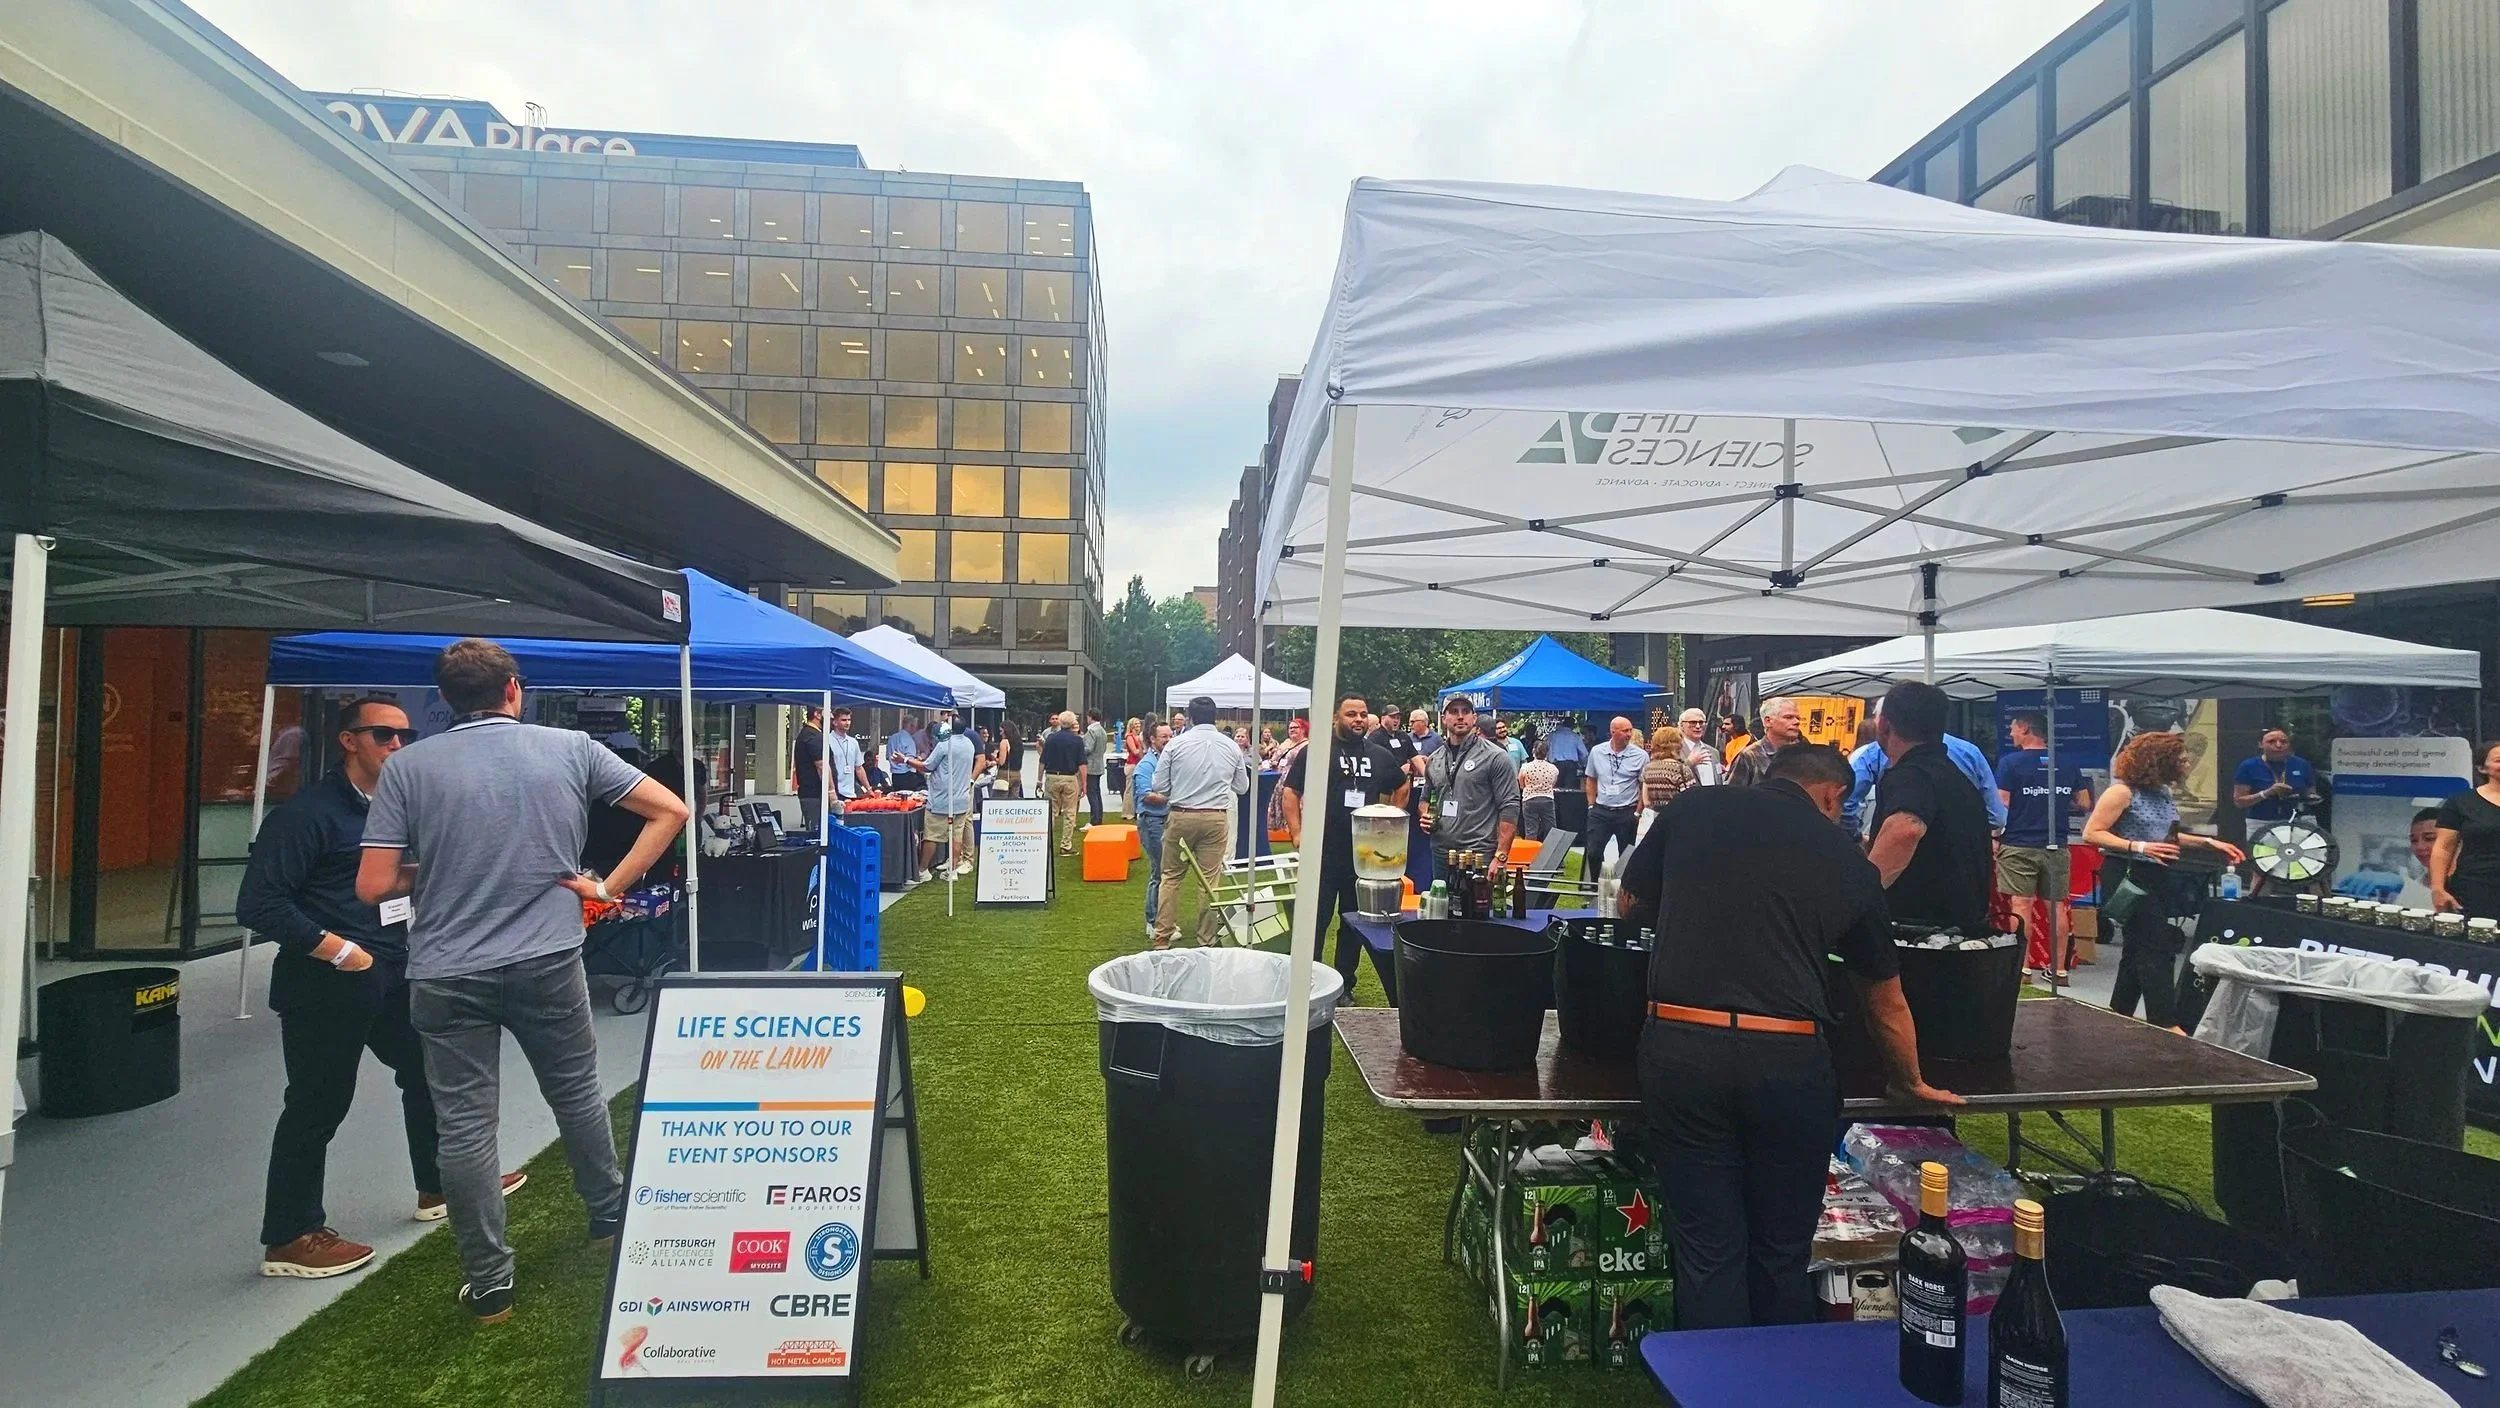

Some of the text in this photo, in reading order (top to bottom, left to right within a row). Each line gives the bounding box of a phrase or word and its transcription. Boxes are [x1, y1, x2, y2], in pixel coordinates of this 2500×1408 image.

[988, 807, 1043, 816] LIFE SCIENCES
[677, 1015, 862, 1038] LIFE SCIENCES
[700, 1046, 832, 1070] ON THE LAWN
[661, 1120, 852, 1137] THANK YOU TO OUR
[668, 1147, 838, 1164] EVENT SPONSORS
[654, 1189, 692, 1203] fisher
[692, 1189, 746, 1203] scientific
[792, 1185, 862, 1203] FAROS
[1524, 1190, 1534, 1200] 12
[1603, 1189, 1614, 1199] 12
[653, 1239, 716, 1248] PITTSBURGH
[736, 1240, 783, 1255] COOK
[652, 1249, 714, 1257] LIFE SCIENCES
[651, 1258, 713, 1267] ALLIANCE
[1533, 1260, 1545, 1269] IPA
[1908, 1273, 1946, 1293] DARK HORSE
[1518, 1284, 1528, 1294] 12
[1603, 1286, 1613, 1296] 12
[618, 1300, 750, 1312] GDI AINSWORTH
[769, 1294, 851, 1317] CBRE
[643, 1344, 716, 1358] Collaborative
[787, 1357, 811, 1365] METAL
[812, 1357, 842, 1365] CAMPUS
[1527, 1353, 1539, 1362] IPA
[1612, 1355, 1623, 1363] IPA
